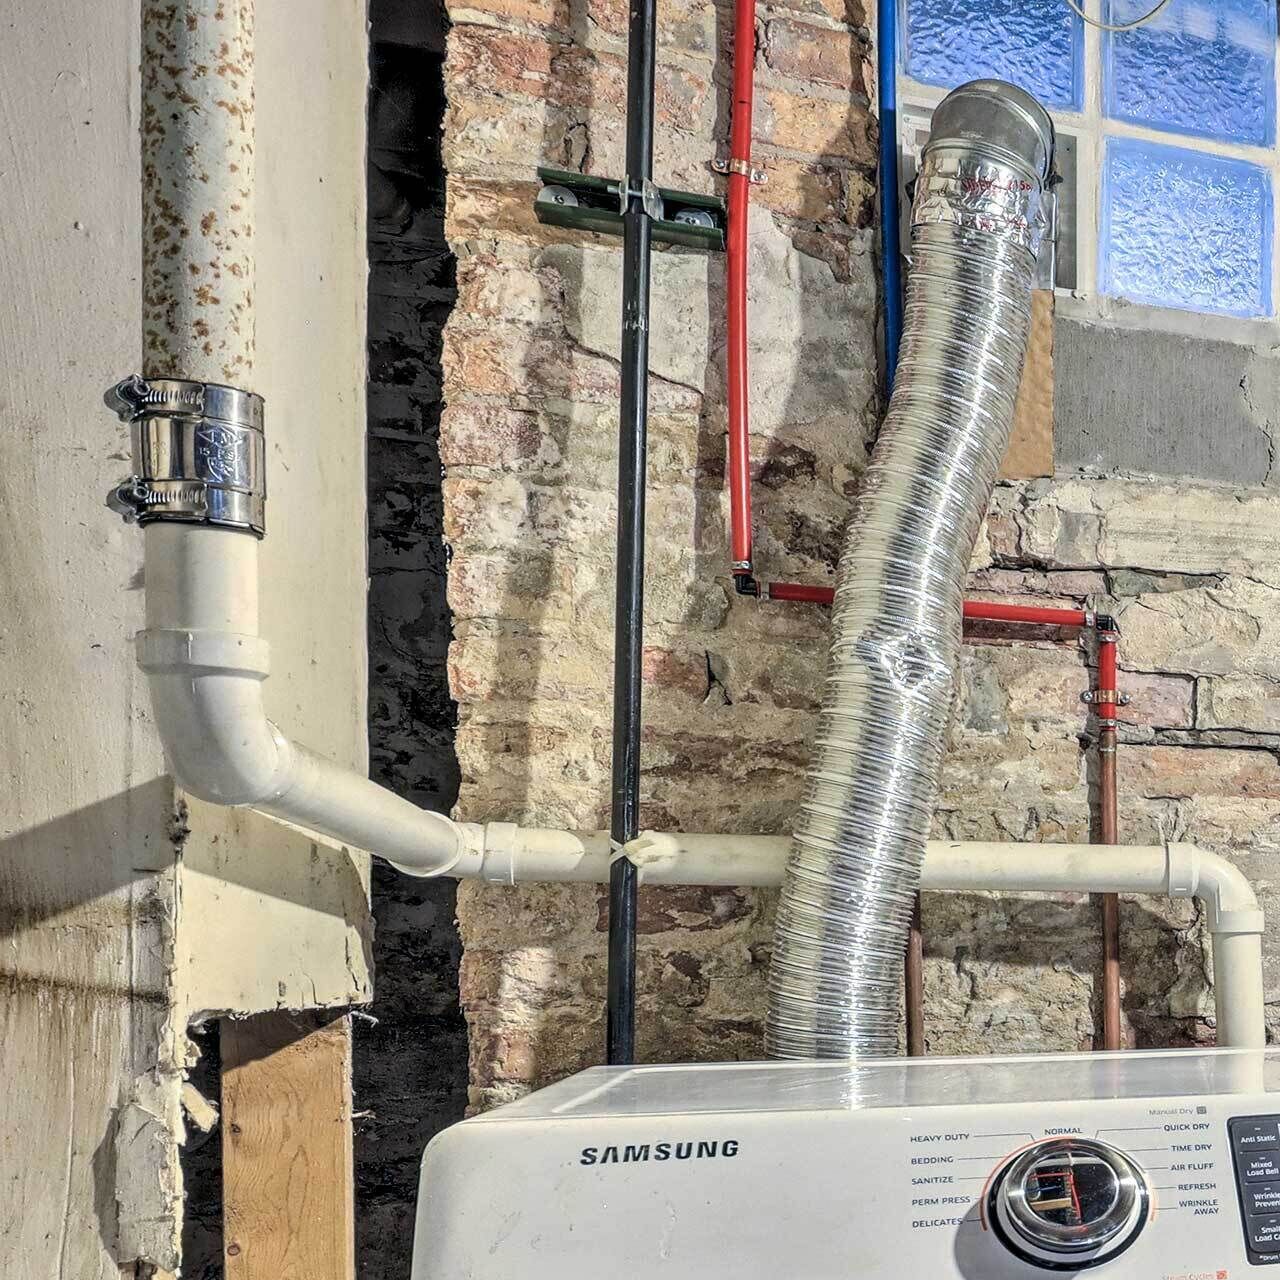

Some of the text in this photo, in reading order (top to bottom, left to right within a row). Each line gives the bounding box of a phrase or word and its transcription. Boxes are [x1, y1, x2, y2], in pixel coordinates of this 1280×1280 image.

[1044, 1127, 1084, 1136] NORMAL
[1163, 1124, 1190, 1132] QUICK
[910, 1133, 970, 1143] HEAVY DUTY
[580, 1140, 738, 1165] SAMSUNG
[911, 1156, 954, 1165] BEDDING
[911, 1176, 954, 1185] SANITIZE
[1178, 1183, 1217, 1191] REFRESH
[942, 1196, 971, 1204] PRESS
[1179, 1199, 1218, 1207] WRINKLE
[912, 1218, 964, 1228] DELICATES
[1261, 1225, 1280, 1234] Small
[1255, 1234, 1273, 1242] Load
